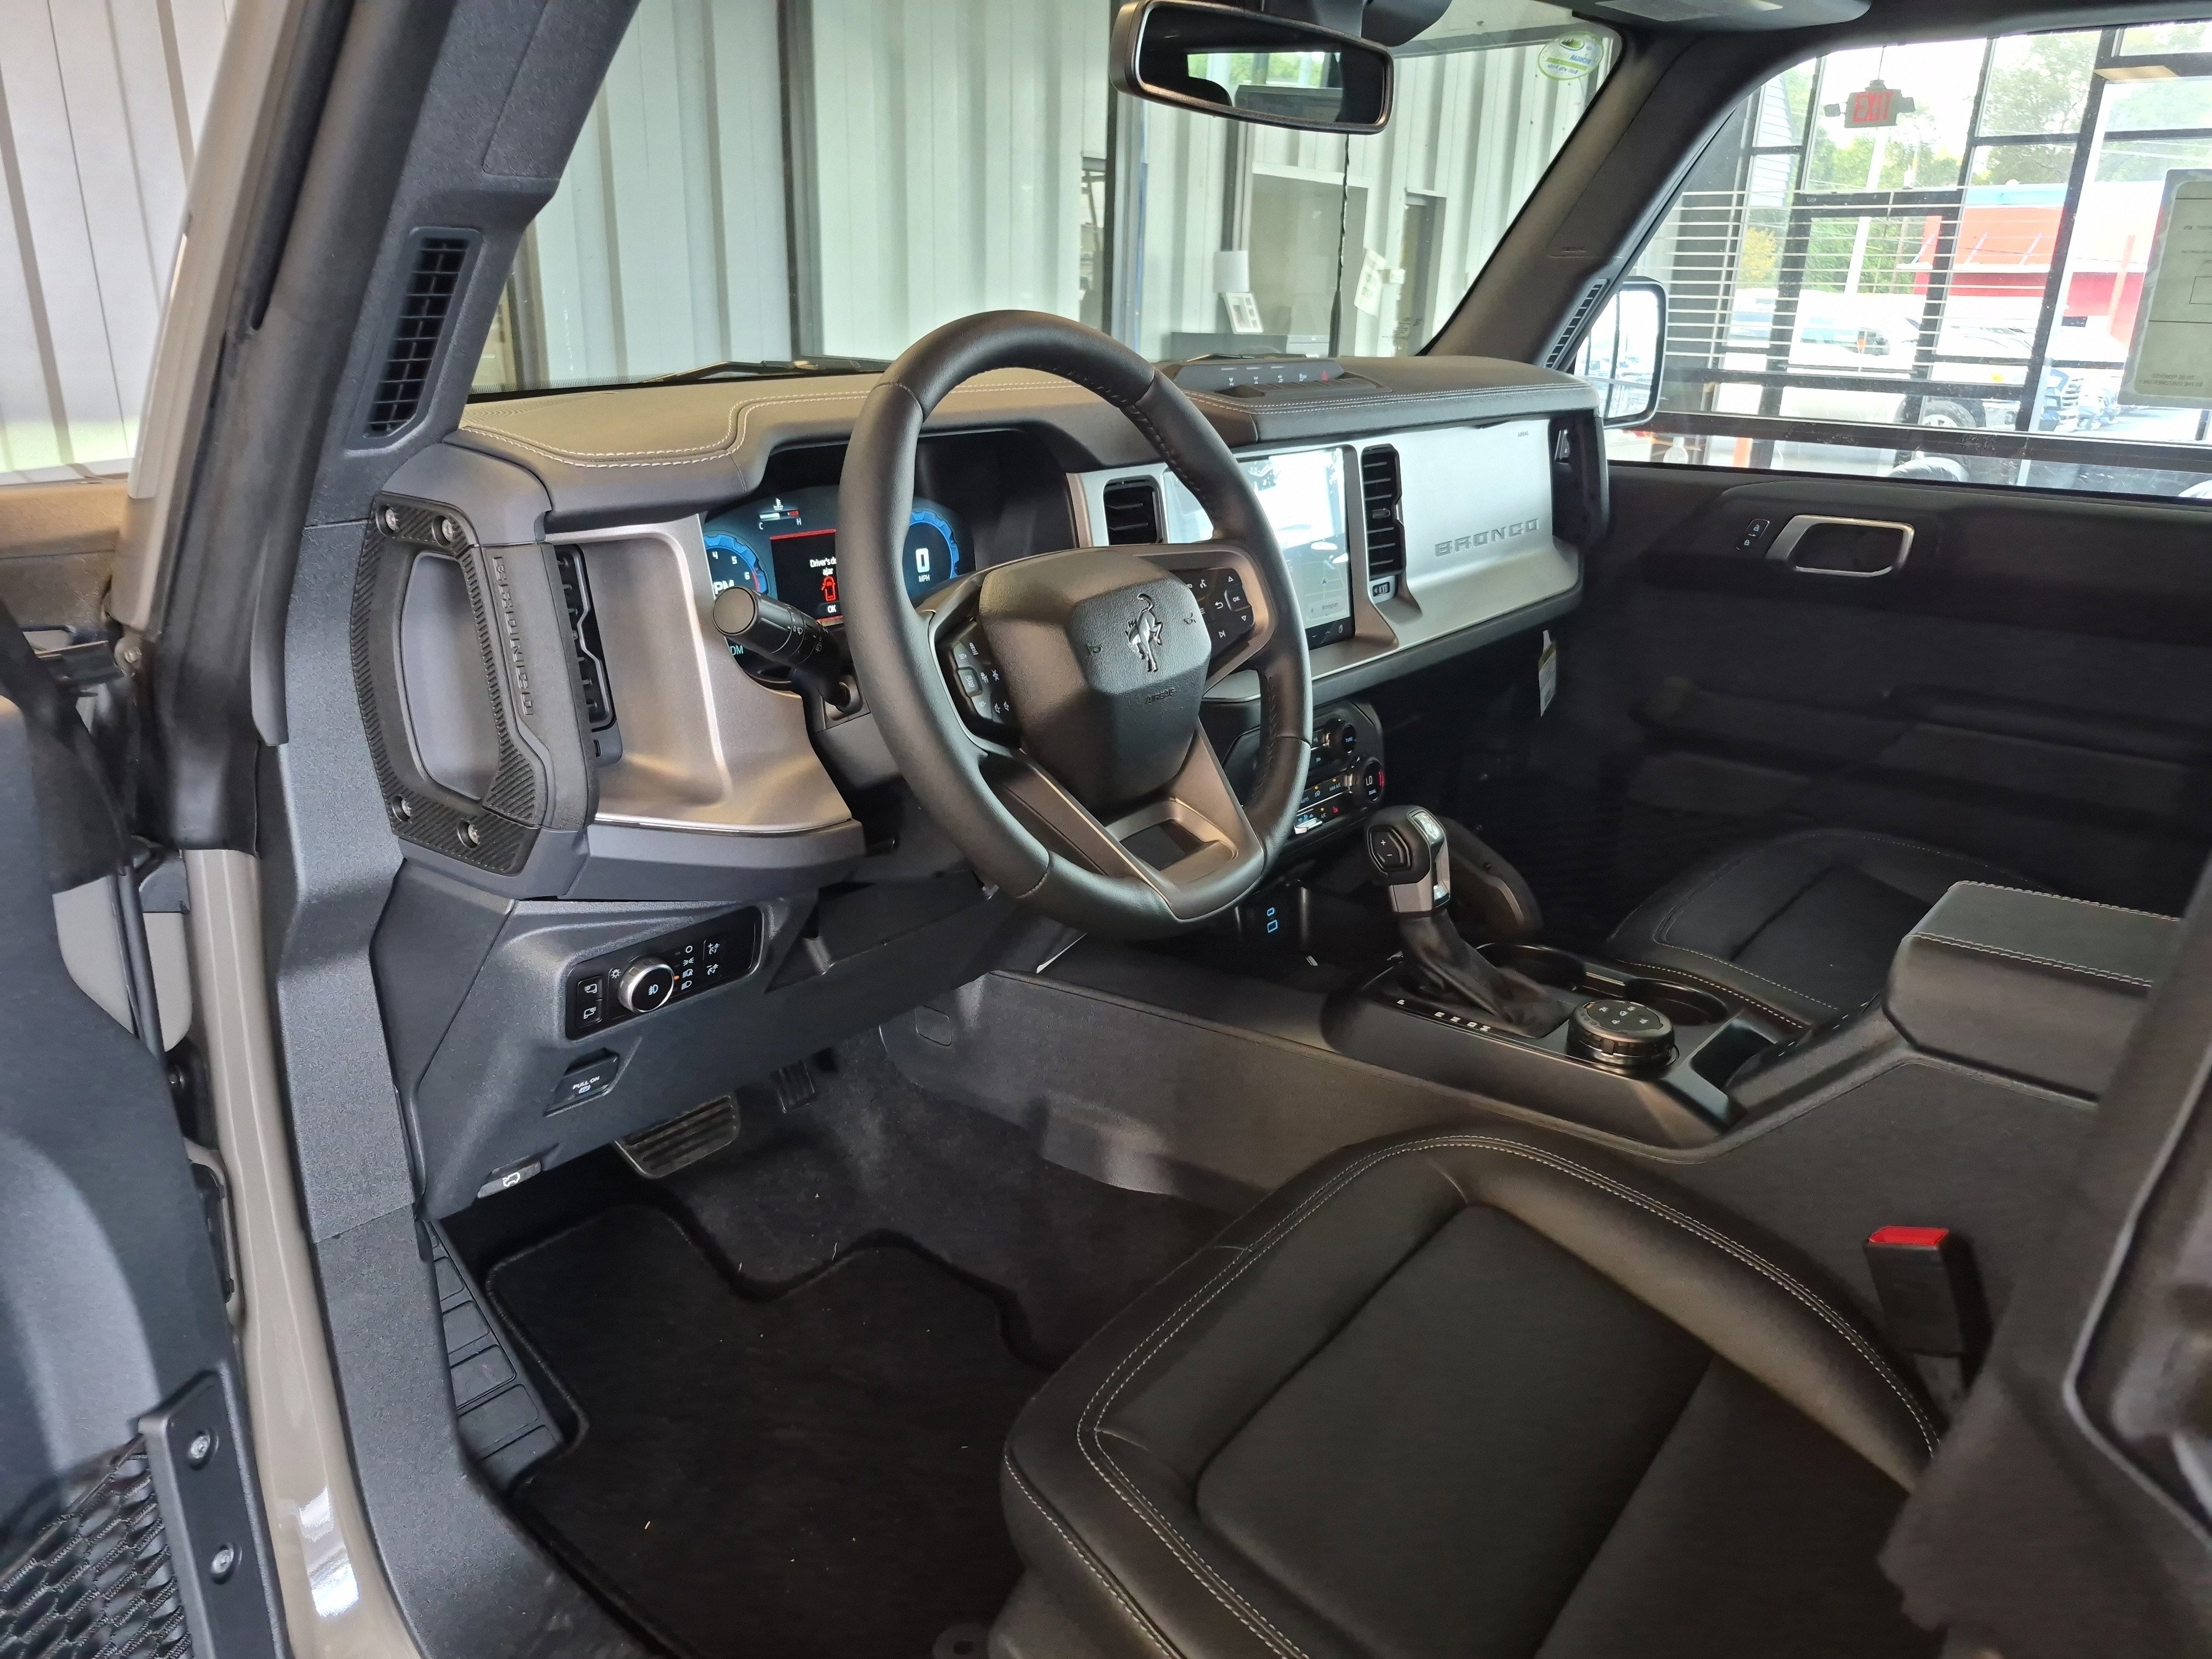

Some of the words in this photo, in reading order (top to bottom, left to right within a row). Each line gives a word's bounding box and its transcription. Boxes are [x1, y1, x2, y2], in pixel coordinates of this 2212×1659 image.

[1852, 91, 1895, 123] EXIT
[758, 522, 764, 530] C
[796, 518, 802, 526] H
[1435, 518, 1540, 558] BRONCO
[732, 556, 737, 564] 5
[916, 548, 930, 573] 0
[744, 572, 750, 580] 6
[822, 567, 833, 576] ajar
[918, 574, 930, 583] MPH
[827, 605, 837, 613] OK
[492, 556, 534, 716] BRONCO
[1366, 775, 1373, 786] LO
[572, 1081, 589, 1090] PULL
